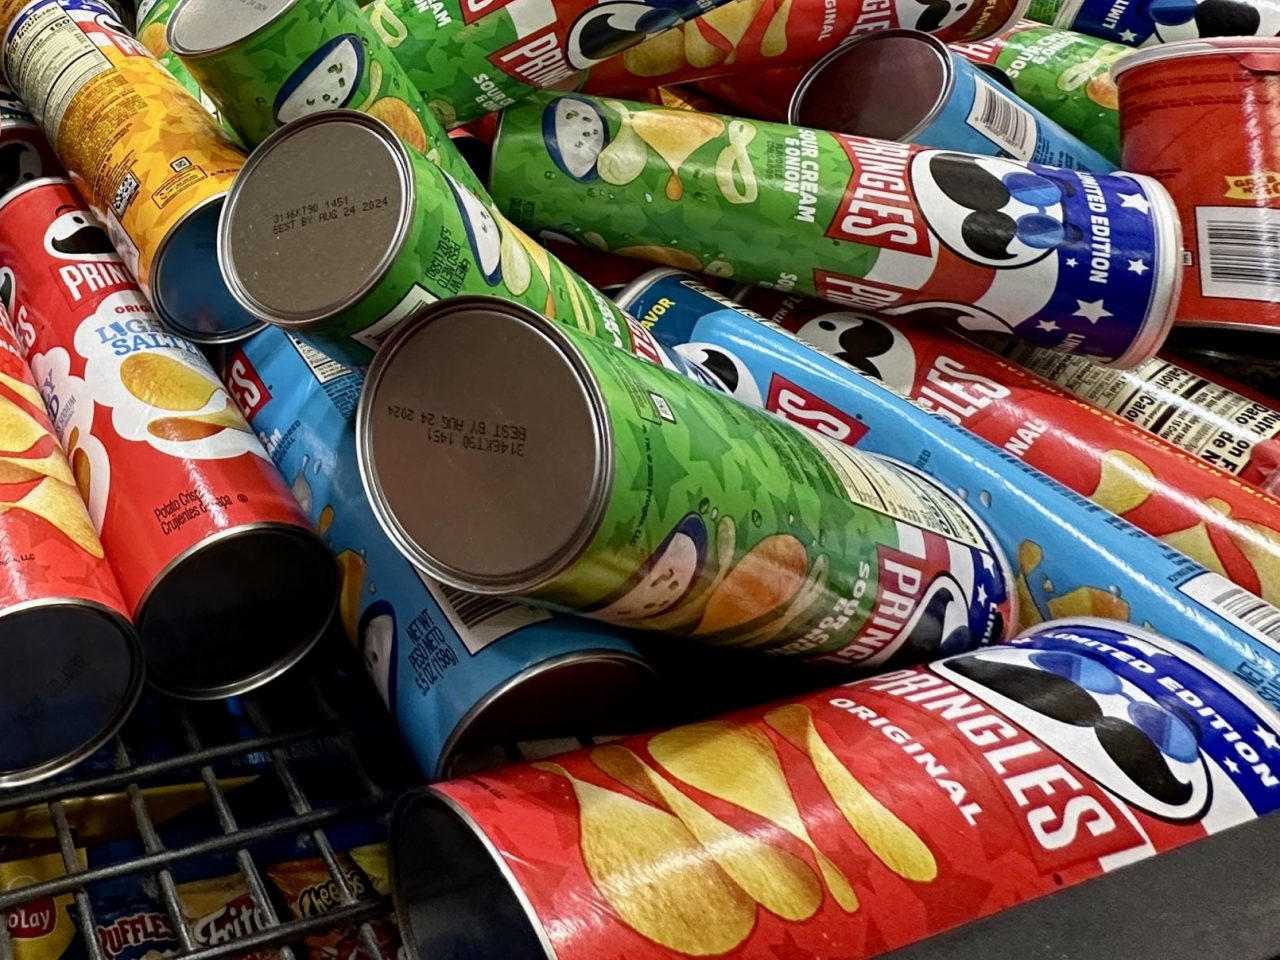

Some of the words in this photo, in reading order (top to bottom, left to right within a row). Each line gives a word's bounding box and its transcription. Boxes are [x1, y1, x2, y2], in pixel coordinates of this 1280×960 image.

[798, 128, 819, 162] SOUR
[783, 148, 799, 194] ONION
[839, 133, 920, 246] PRINGLES
[324, 196, 349, 209] 1451
[794, 163, 818, 224] CREAM
[273, 222, 296, 235] BEST
[301, 217, 314, 228] BY
[319, 209, 338, 224] AUG
[343, 206, 356, 218] 24
[362, 196, 389, 211] 2024
[1089, 214, 1112, 284] EDITION
[387, 405, 416, 420] 2024
[437, 416, 464, 430] AUG
[493, 425, 526, 441] BEST
[154, 497, 179, 522] Potato
[161, 507, 200, 536] Crujientes
[1044, 631, 1158, 676] LIMITED
[1156, 676, 1279, 788] EDITION
[829, 697, 984, 828] ORIGINAL
[850, 669, 1117, 852] PRINGLES
